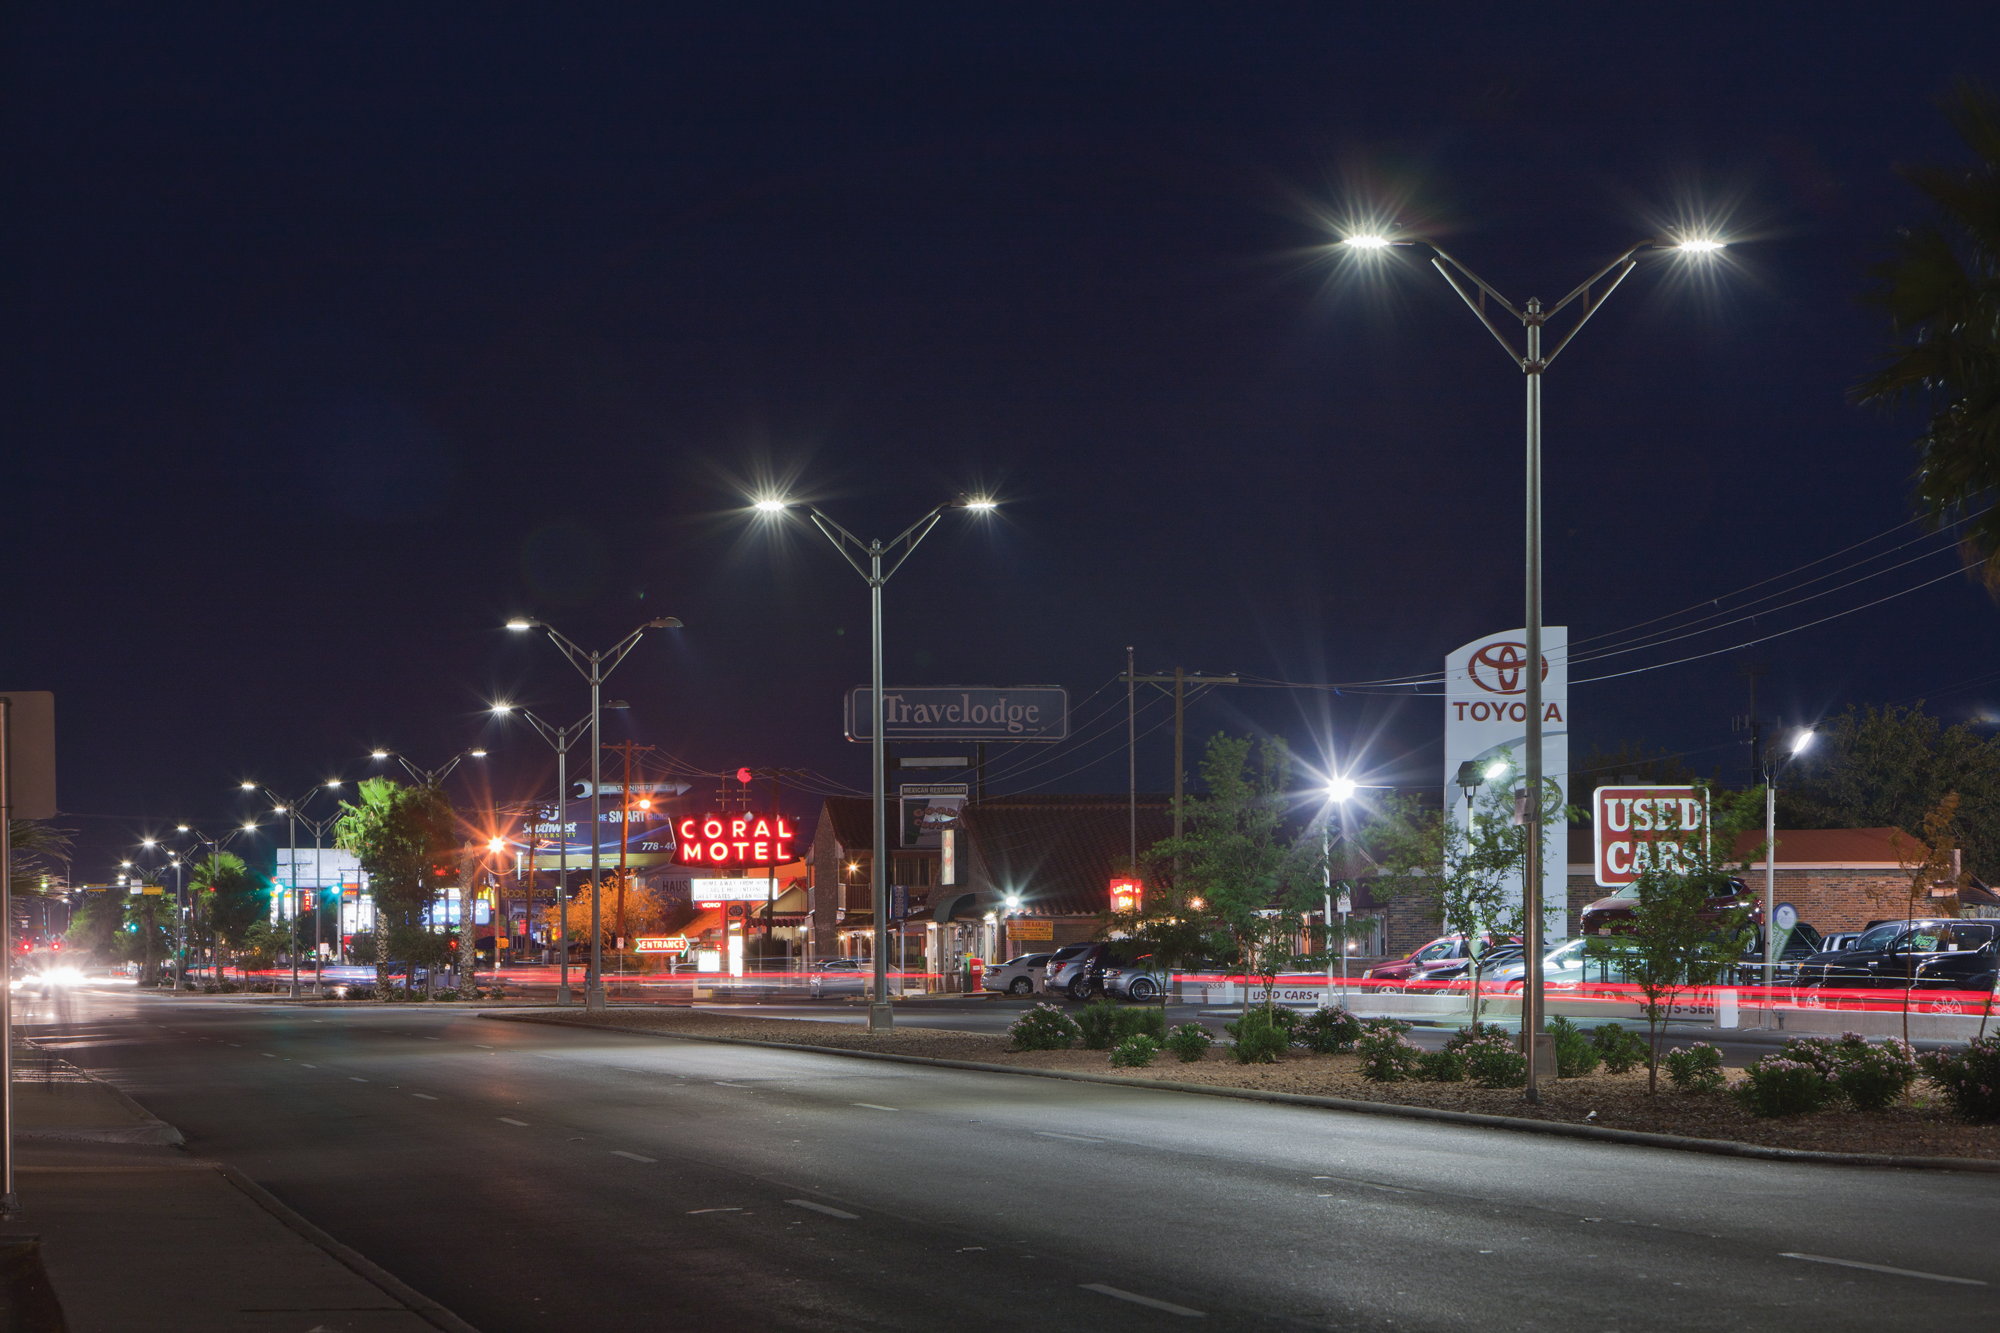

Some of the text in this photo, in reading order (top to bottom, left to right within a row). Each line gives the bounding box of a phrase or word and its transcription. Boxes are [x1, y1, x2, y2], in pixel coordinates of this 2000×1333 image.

[882, 693, 1040, 733] Travelodge
[1452, 701, 1563, 722] TOYOA
[903, 786, 966, 794] MEXICAN RESTAURANT
[599, 813, 608, 822] HE
[913, 806, 958, 817] GOOD
[1604, 798, 1703, 832] USED
[681, 819, 792, 839] CORAL
[683, 841, 791, 861] MOTEL
[1606, 841, 1703, 876] CARS
[641, 940, 685, 950] ENTRANCE
[1253, 990, 1313, 1001] USD CARS
